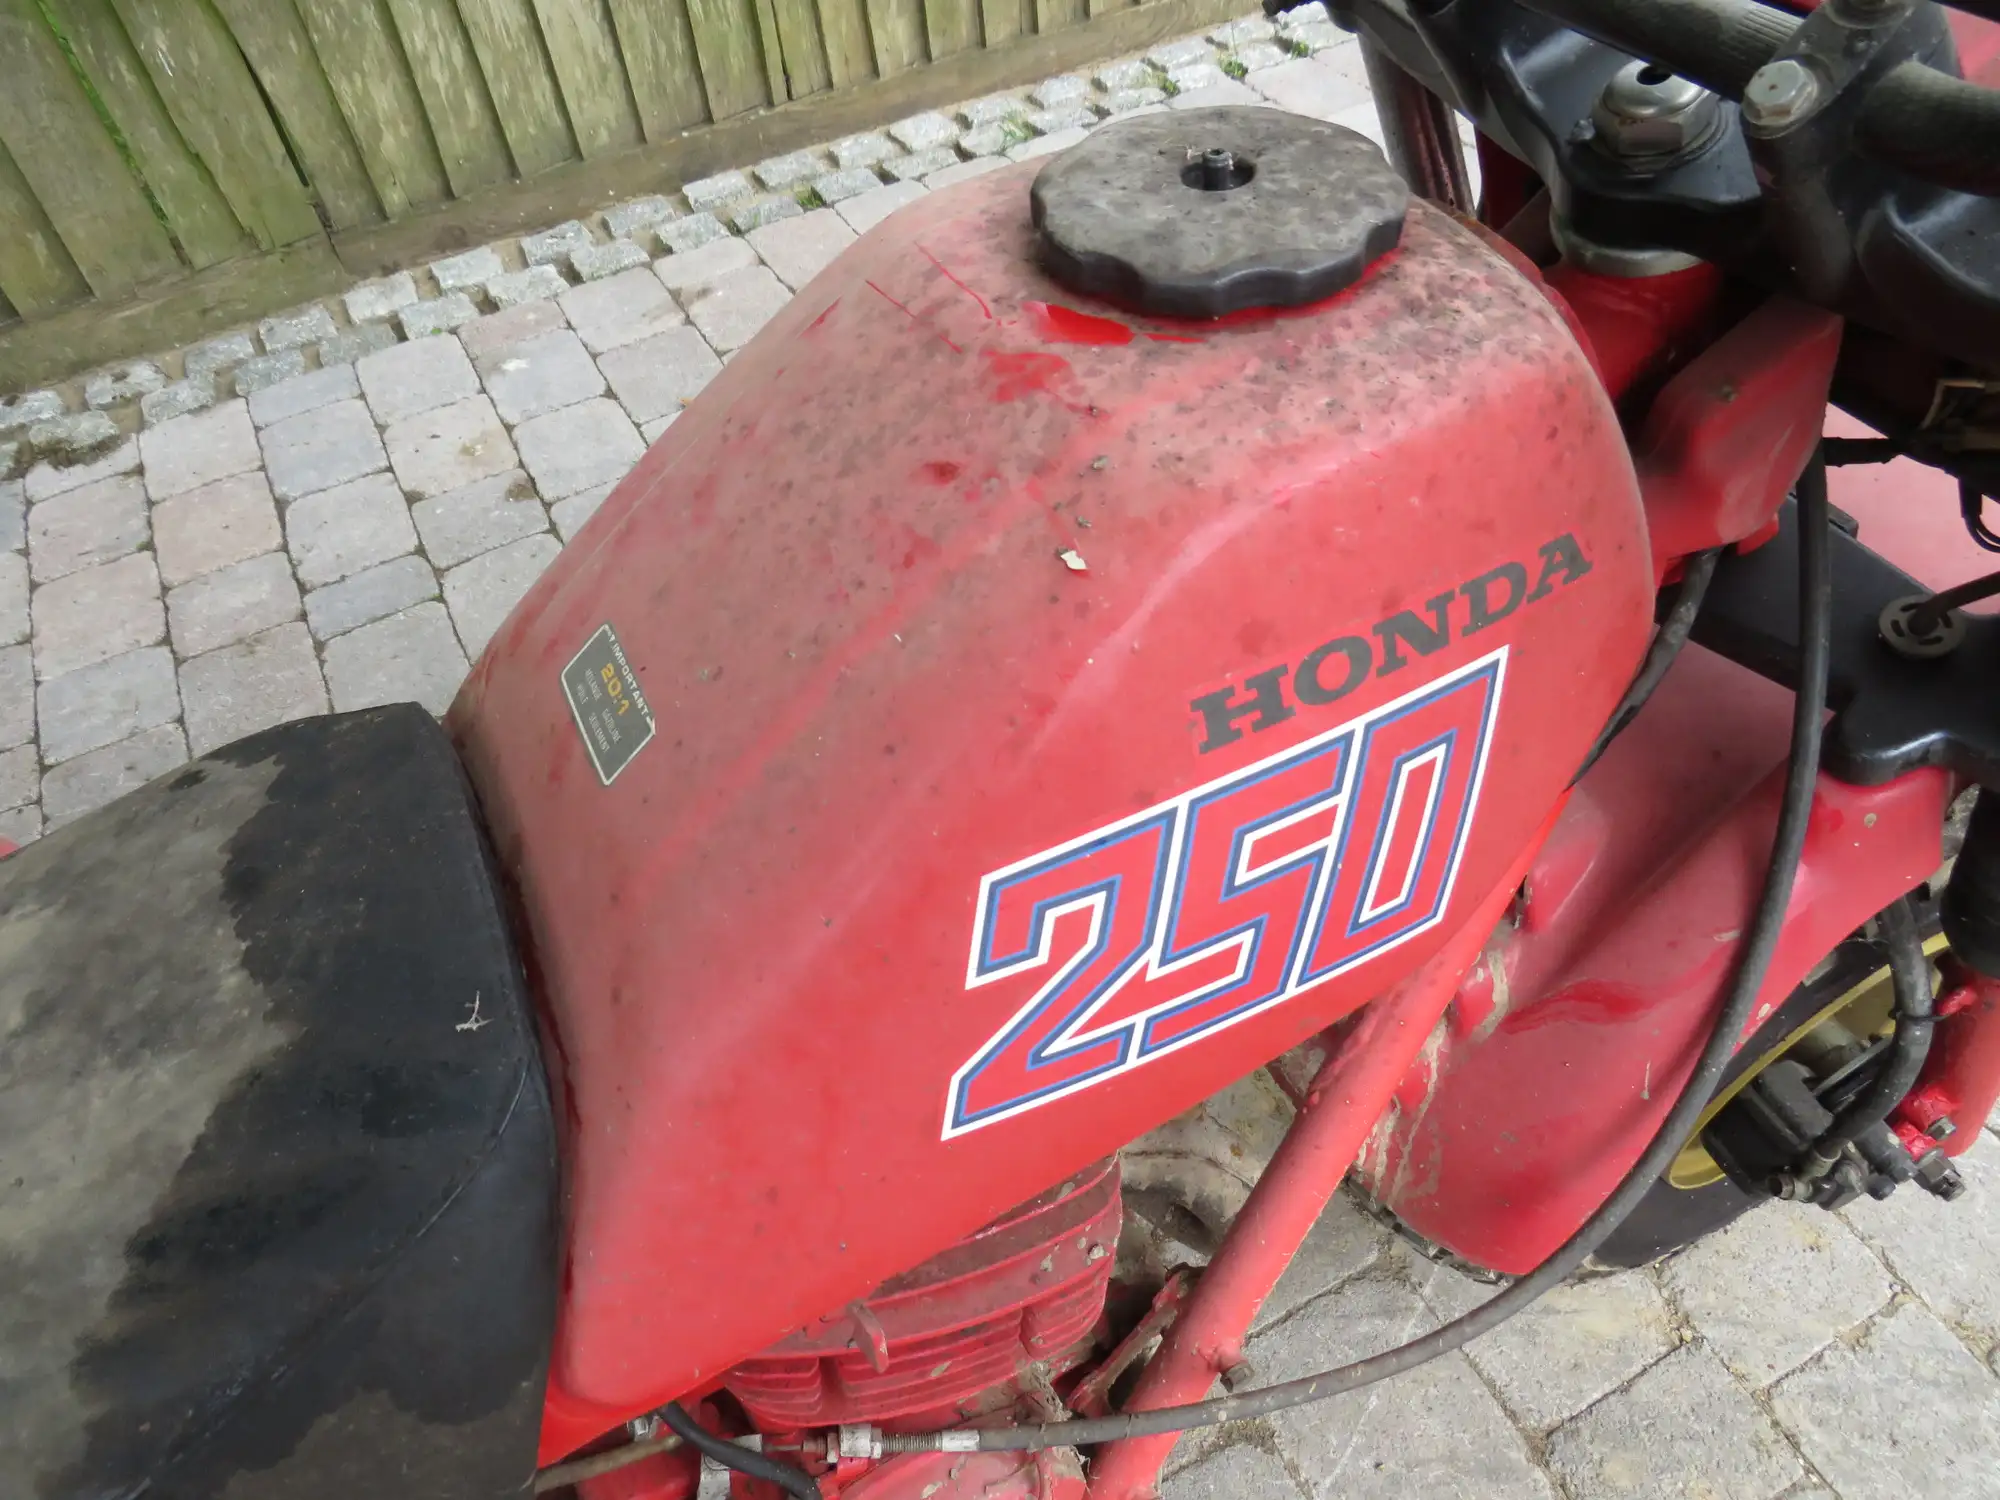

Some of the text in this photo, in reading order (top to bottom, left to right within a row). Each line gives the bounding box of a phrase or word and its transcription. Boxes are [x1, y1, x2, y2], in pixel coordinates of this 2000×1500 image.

[600, 662, 630, 716] 20:1
[612, 642, 649, 717] IMPORTANT
[1190, 532, 1593, 754] HONDA
[941, 644, 1510, 1141] 250
